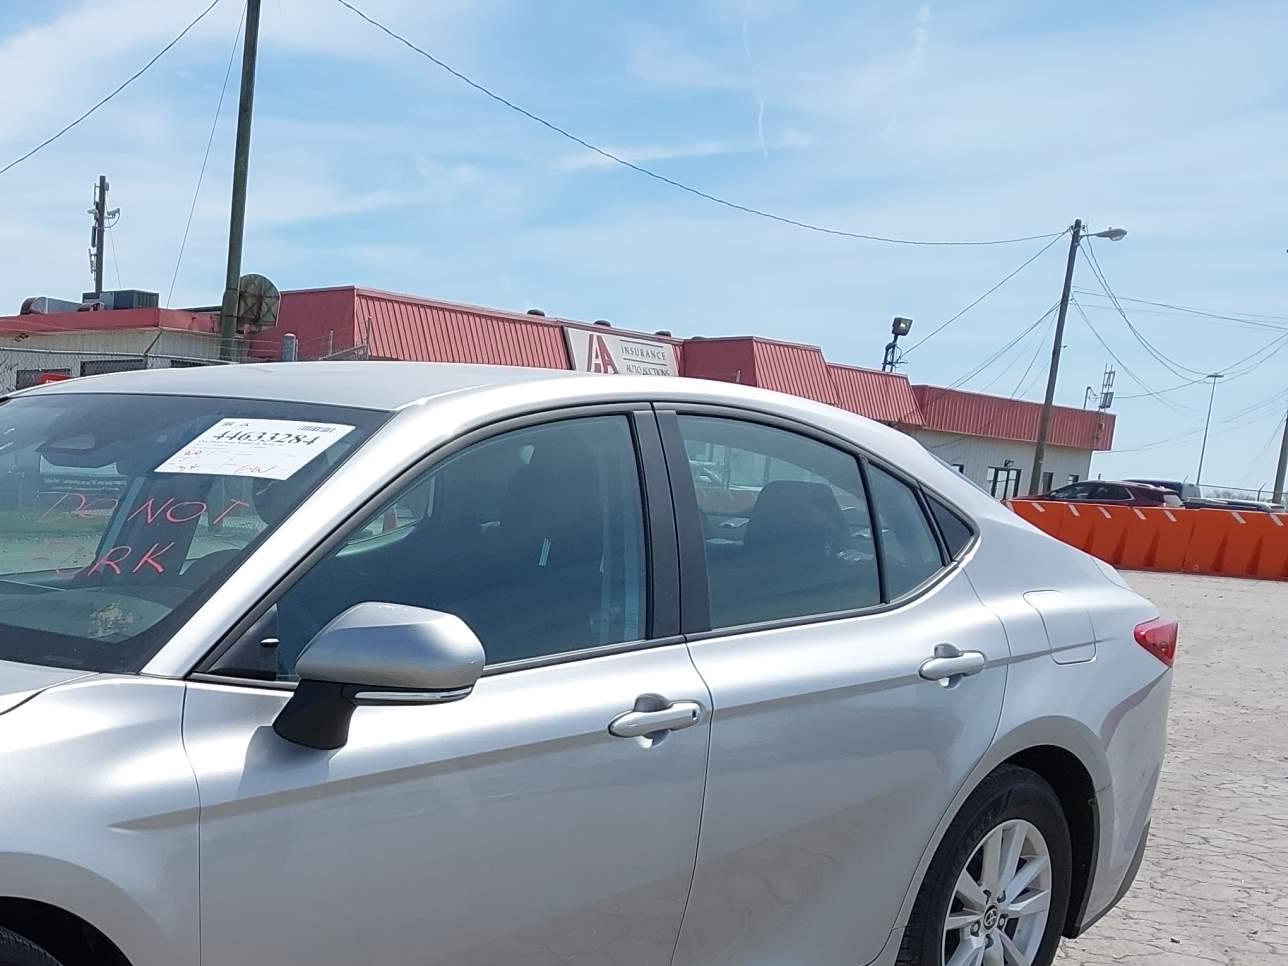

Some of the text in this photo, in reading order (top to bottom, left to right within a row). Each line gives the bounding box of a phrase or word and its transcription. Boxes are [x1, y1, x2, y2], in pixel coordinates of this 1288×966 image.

[621, 345, 666, 361] INSURANCE
[213, 429, 320, 446] 44633284
[127, 497, 250, 525] NOT
